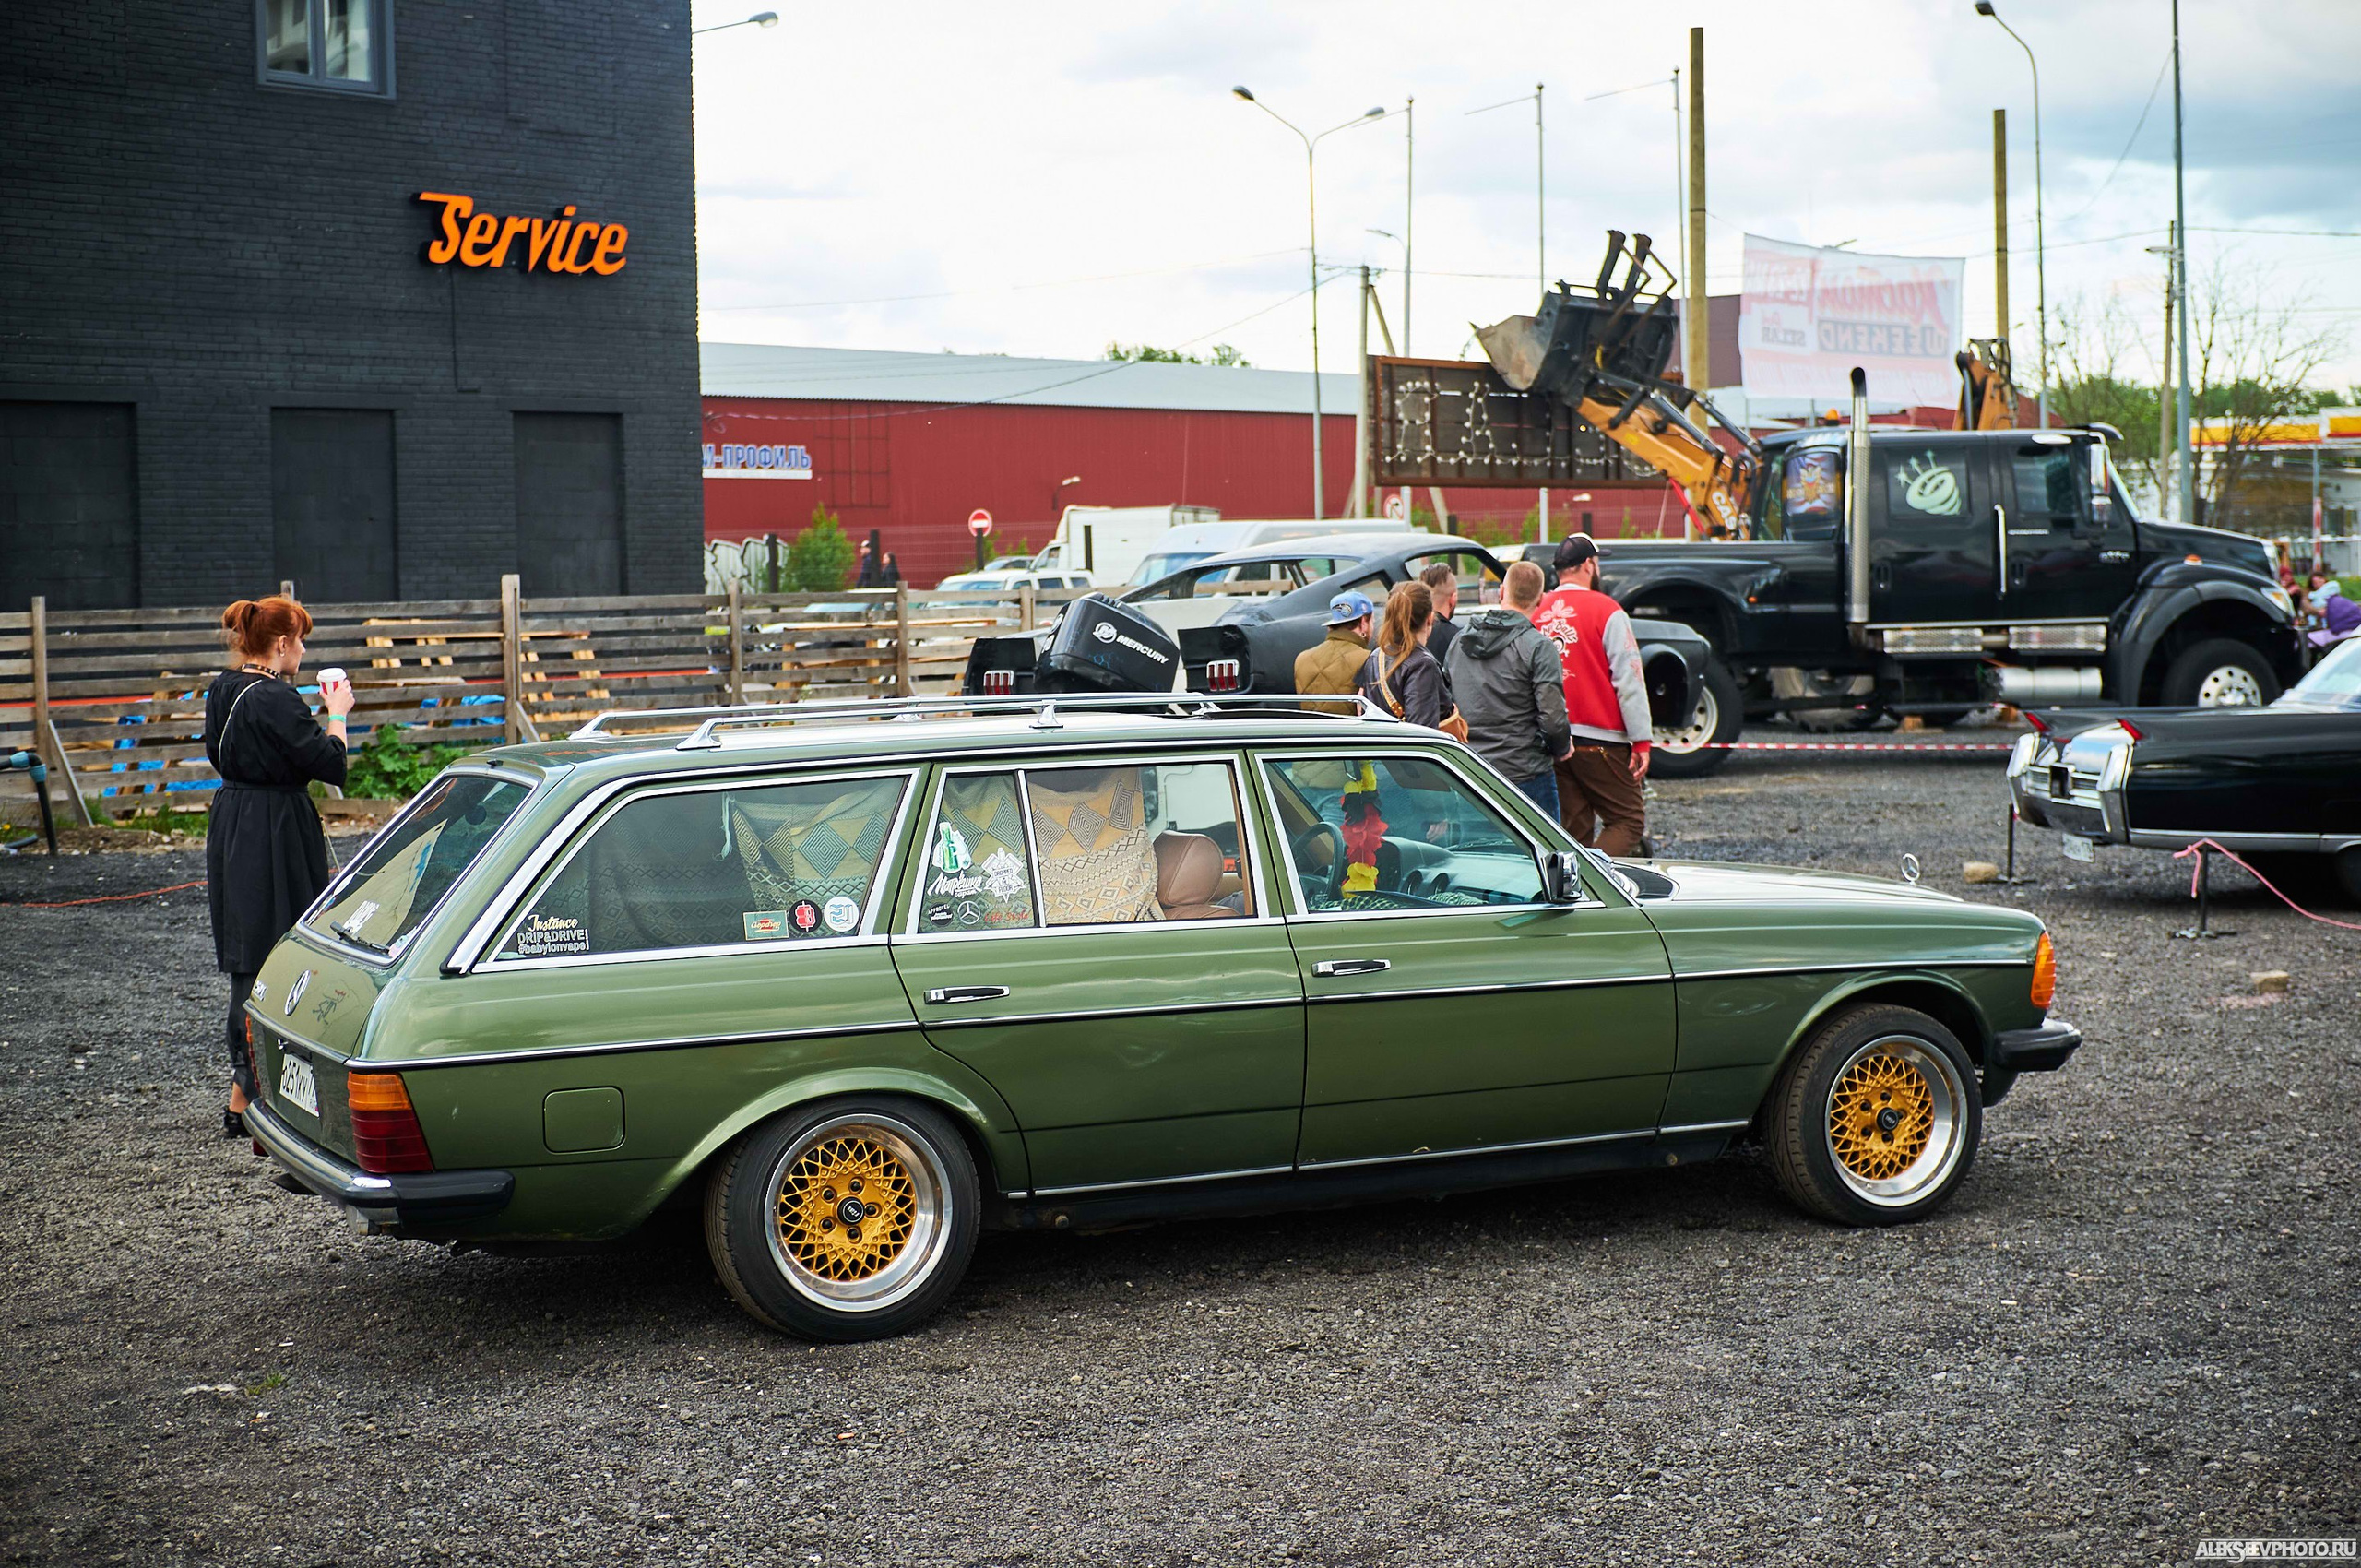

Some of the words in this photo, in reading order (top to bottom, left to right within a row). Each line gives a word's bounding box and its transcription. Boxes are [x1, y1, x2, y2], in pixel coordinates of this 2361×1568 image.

[419, 191, 629, 276] Service
[1116, 634, 1169, 664] MERCURY
[528, 914, 578, 932] Instance
